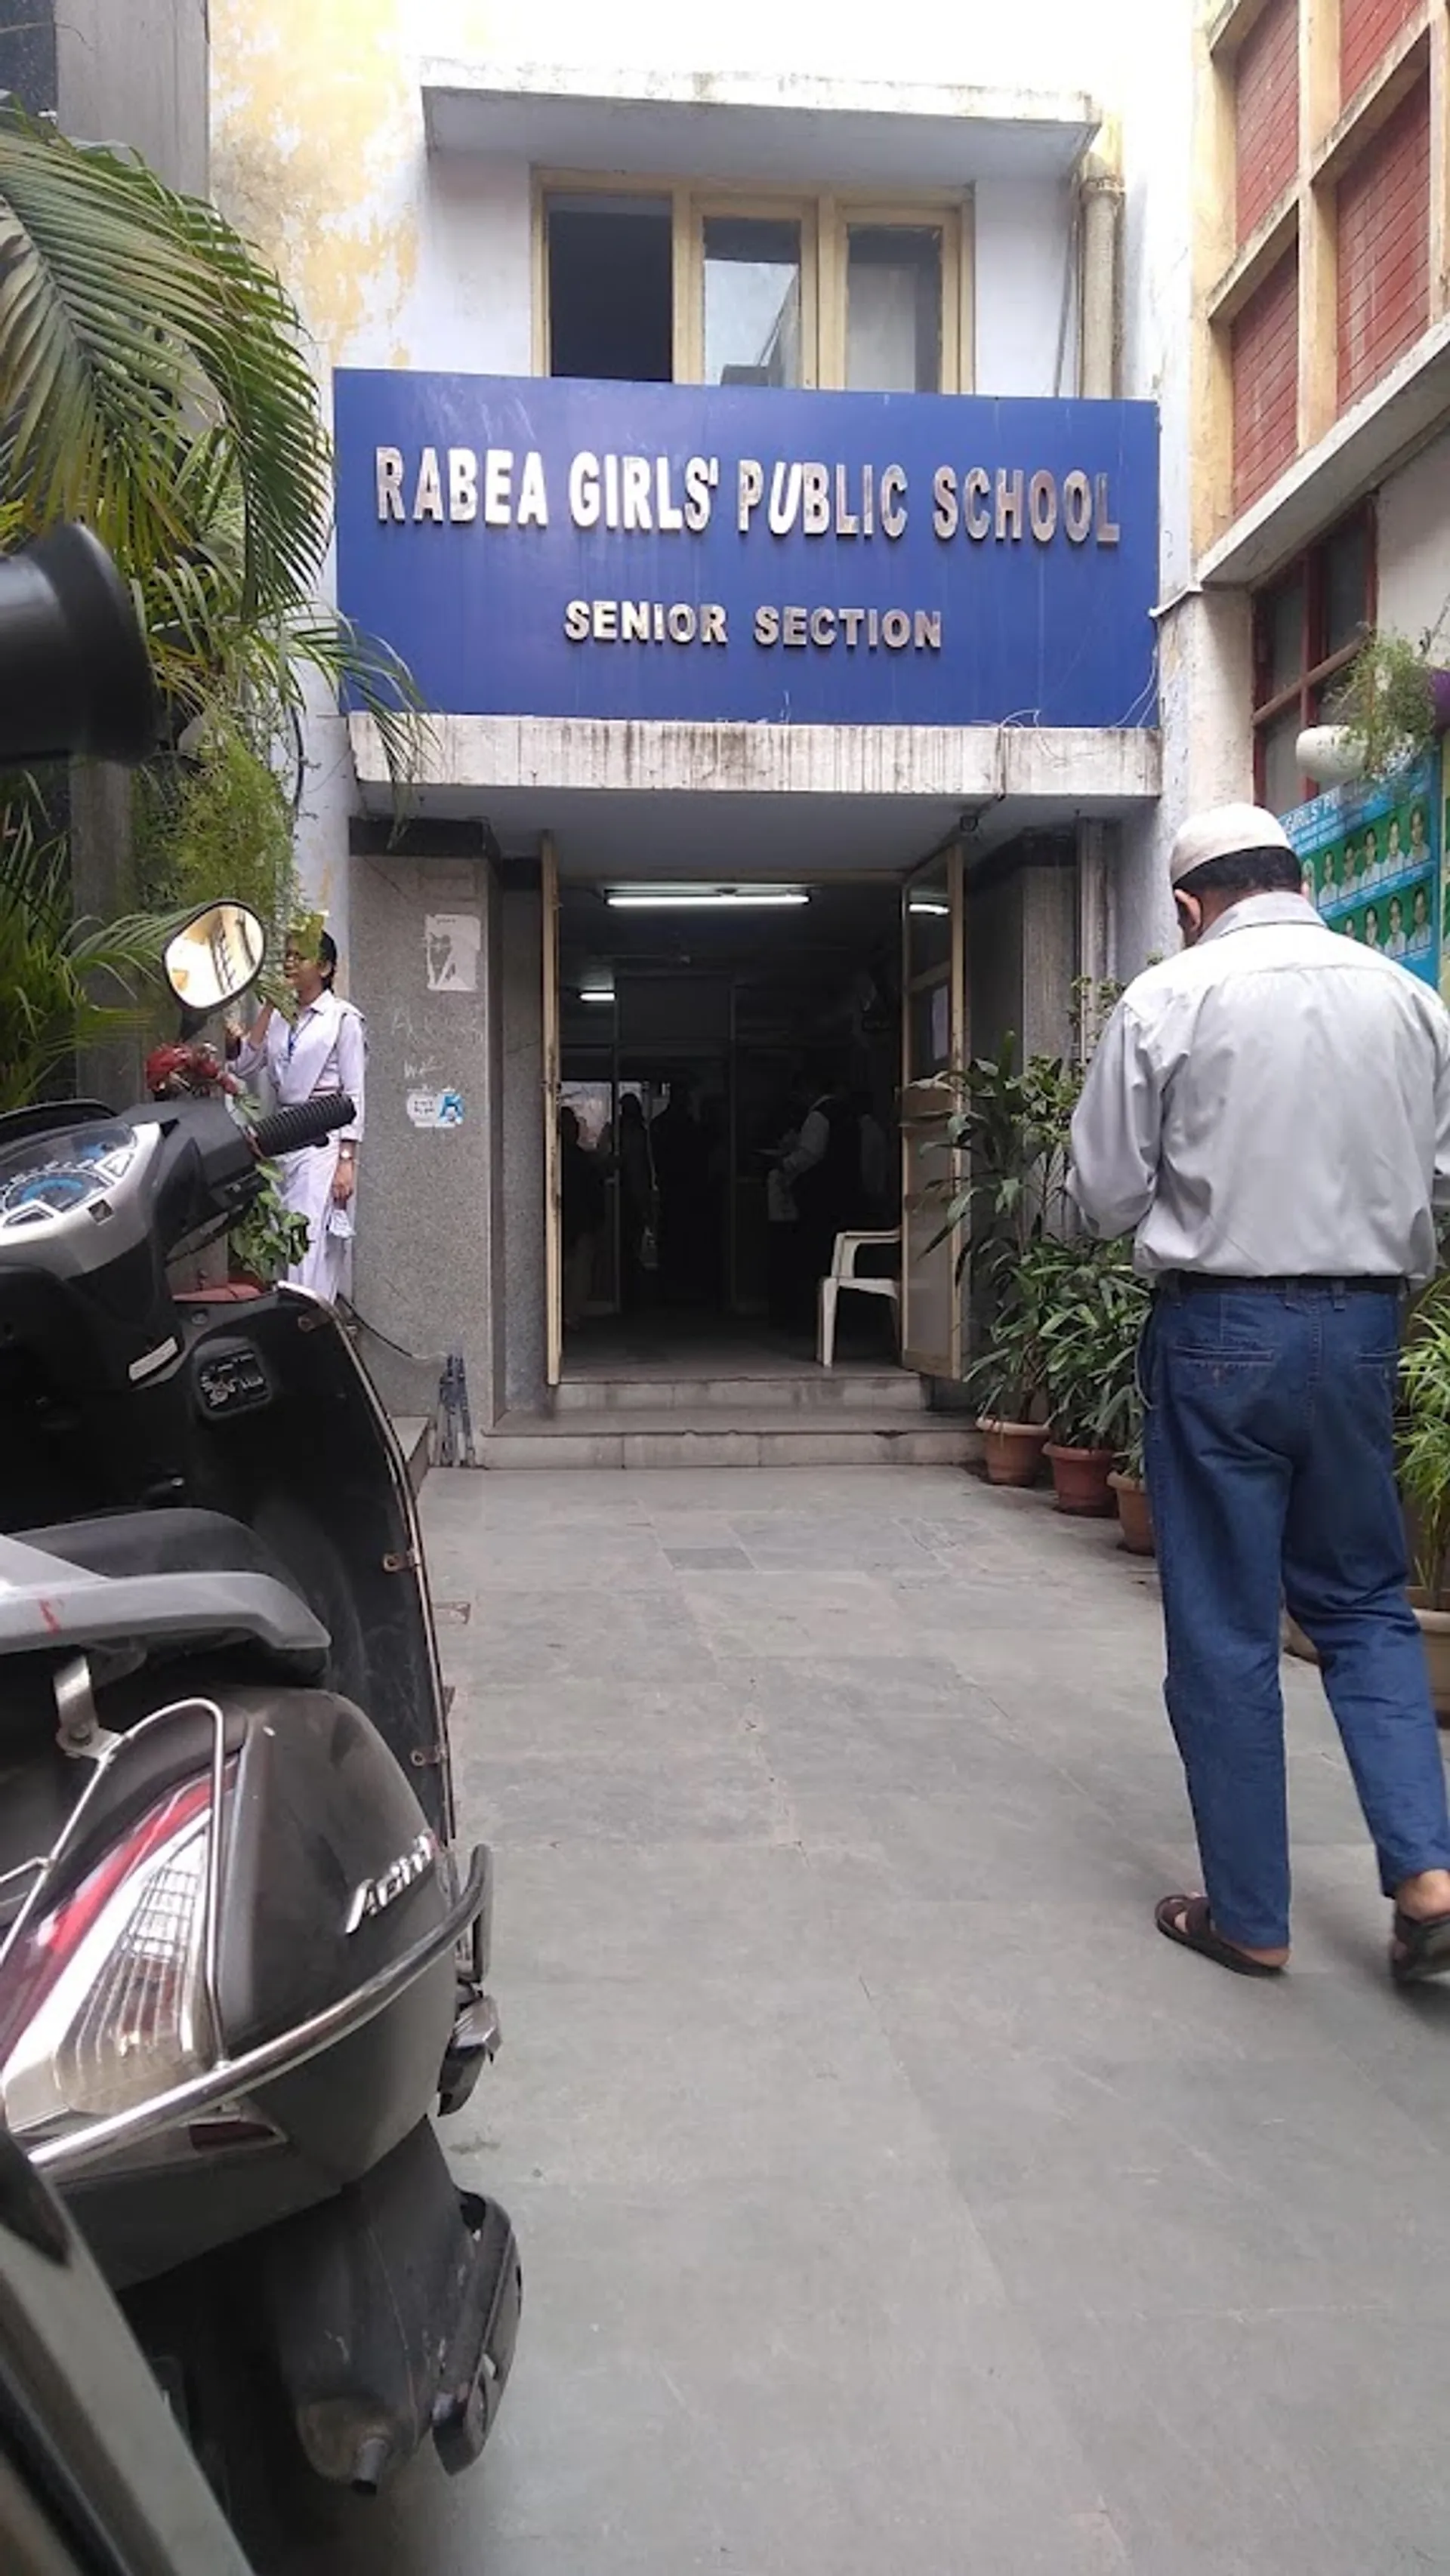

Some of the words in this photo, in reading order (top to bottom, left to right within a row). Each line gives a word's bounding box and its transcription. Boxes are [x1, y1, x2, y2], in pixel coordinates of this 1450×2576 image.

[376, 447, 549, 526] RABEA
[569, 451, 719, 532] GIRLS'
[738, 459, 908, 537] PUBLIC
[933, 464, 1121, 544] SCHOOL
[564, 600, 729, 643] SENIOR
[753, 605, 942, 649] SECTION
